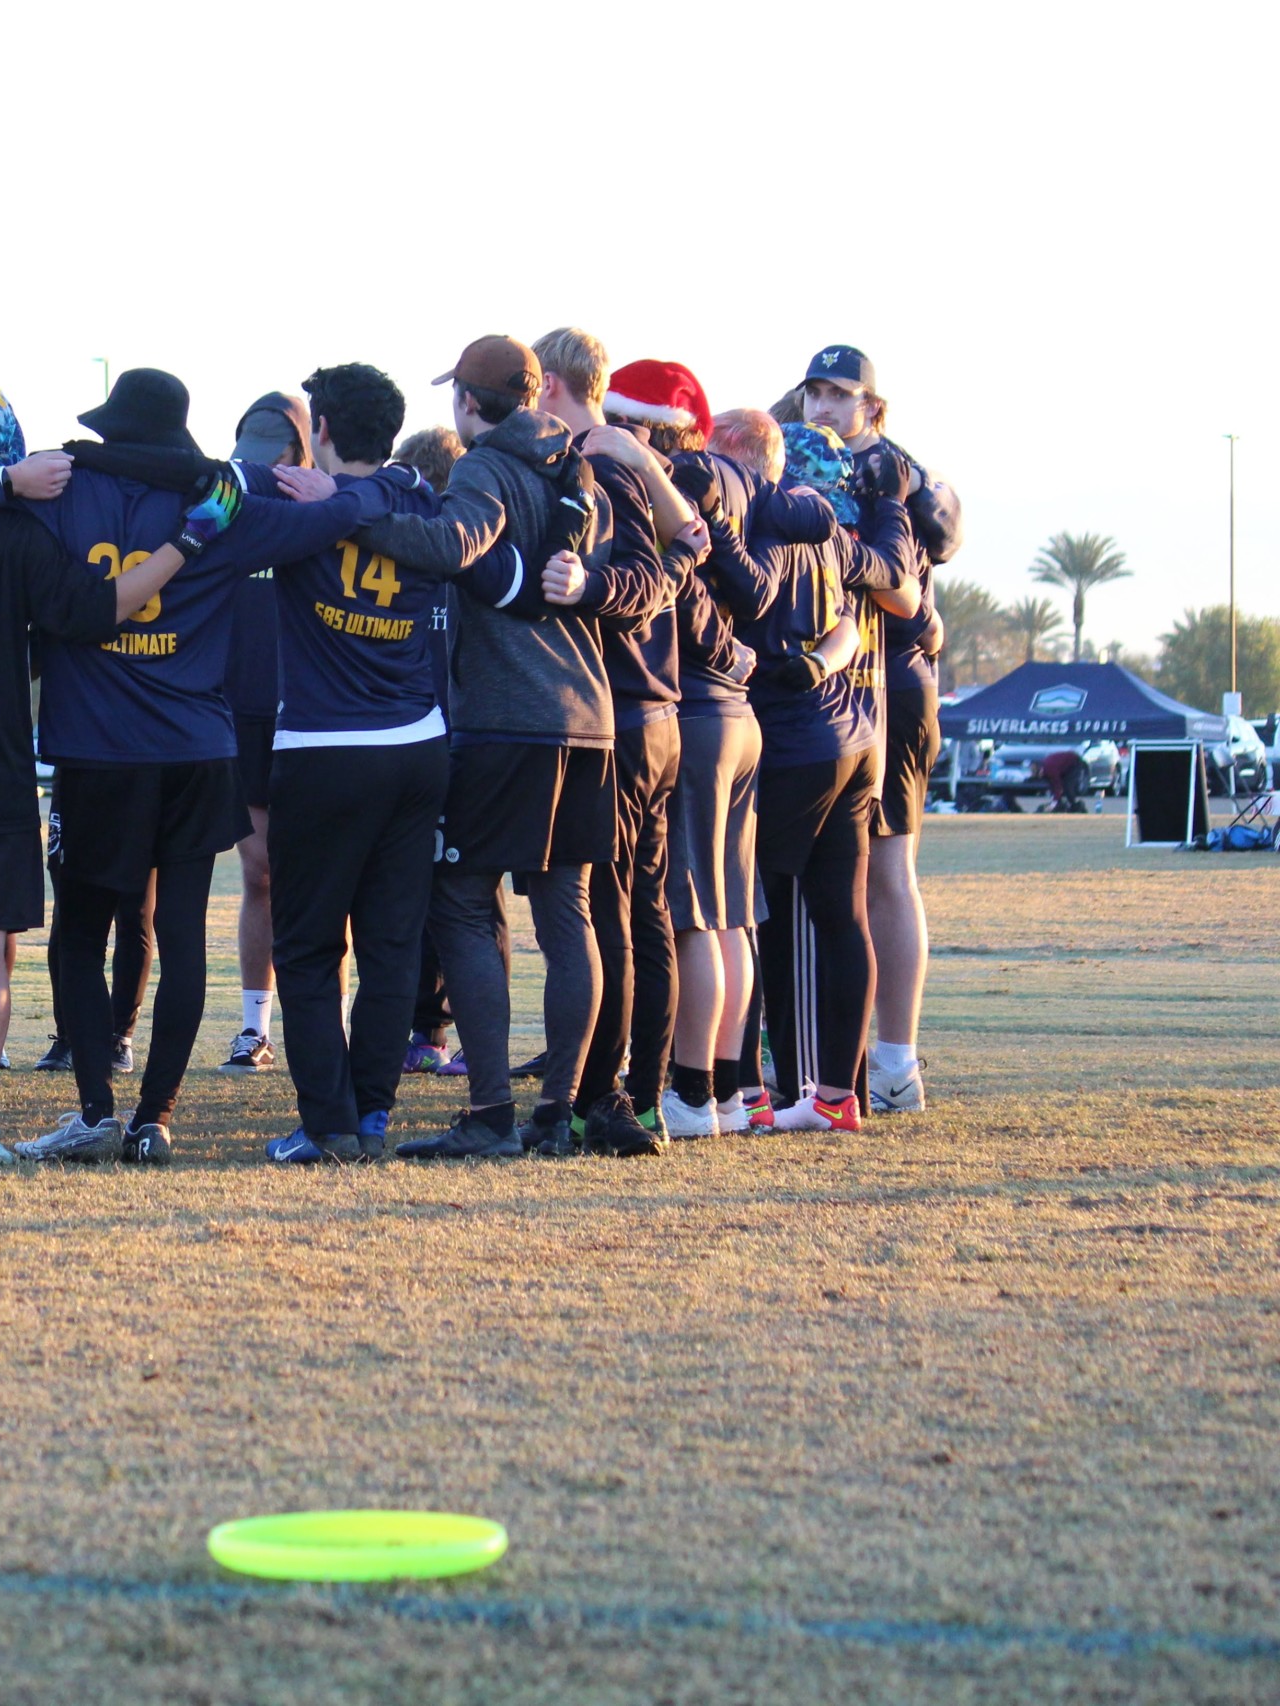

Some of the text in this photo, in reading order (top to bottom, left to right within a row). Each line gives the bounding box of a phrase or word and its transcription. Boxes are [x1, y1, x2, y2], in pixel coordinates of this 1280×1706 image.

[336, 540, 401, 608] 14
[315, 601, 414, 640] 585 ULTIMATE
[966, 718, 1127, 735] SILVERLAKES SPORTS
